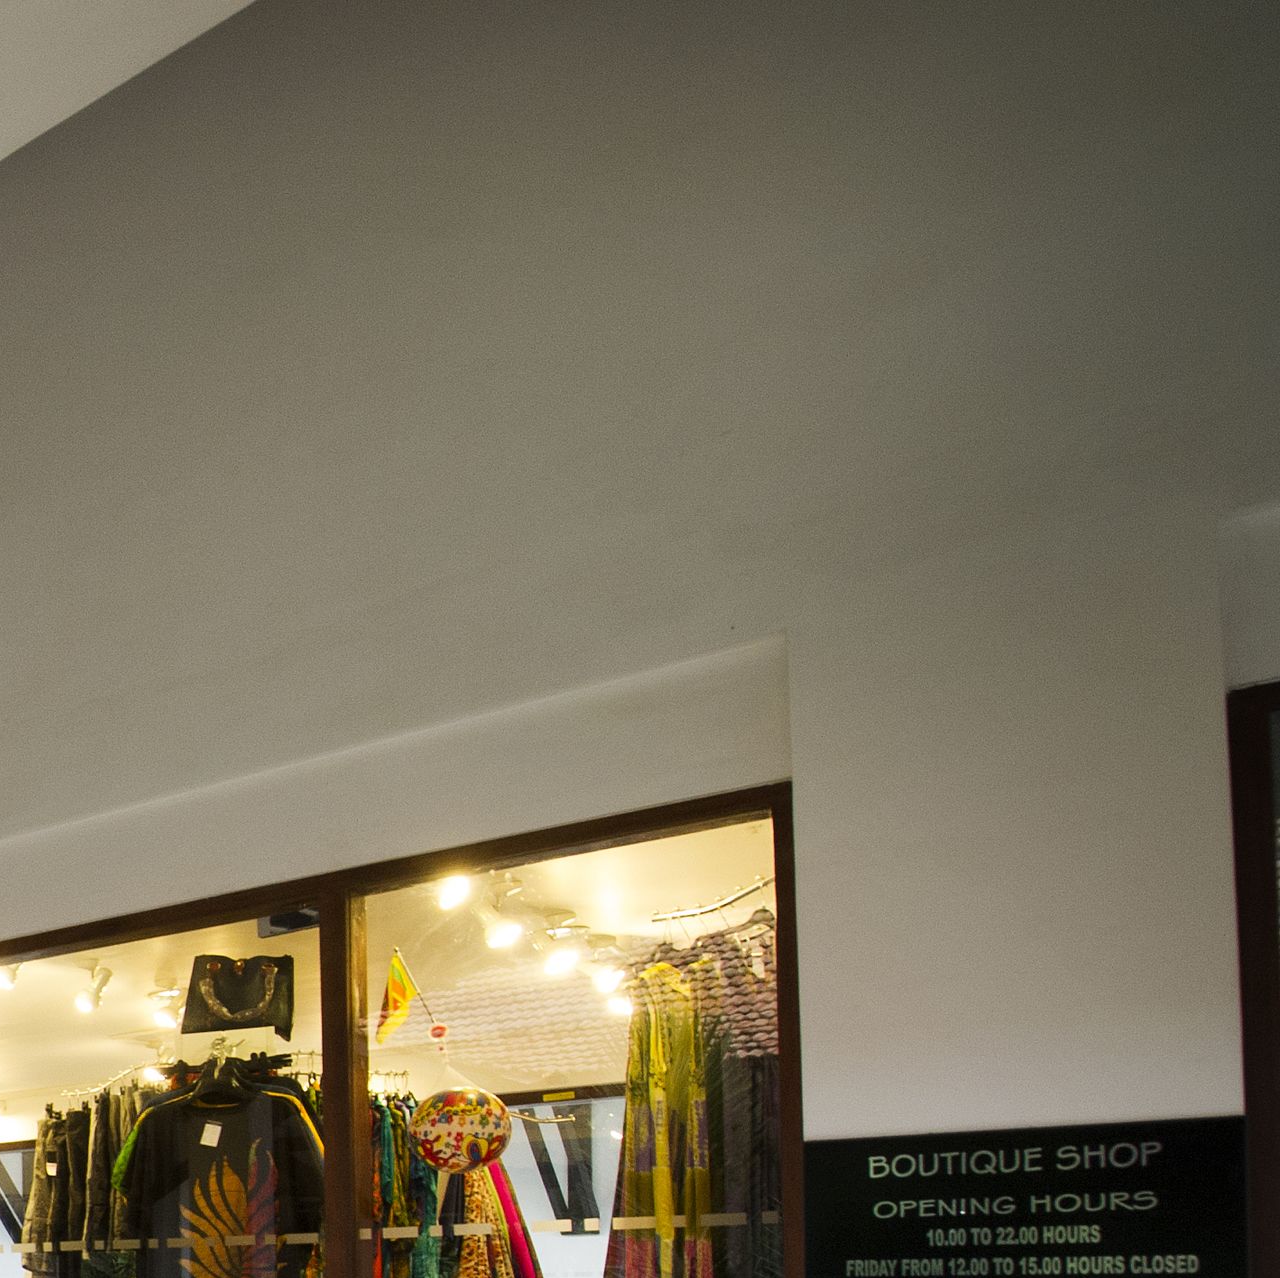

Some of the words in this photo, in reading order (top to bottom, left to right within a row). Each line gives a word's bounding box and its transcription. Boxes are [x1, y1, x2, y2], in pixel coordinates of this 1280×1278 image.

[868, 1147, 1042, 1179] BOUTIQUE
[1056, 1141, 1163, 1171] SHOP
[873, 1195, 1017, 1219] OPENING
[1030, 1190, 1158, 1214] HOURS
[926, 1228, 967, 1247] 10.00
[970, 1227, 991, 1246] TO
[996, 1226, 1038, 1246] 22.00
[1043, 1224, 1102, 1244] HOURS
[846, 1259, 897, 1277] FRIDAY
[901, 1258, 944, 1277] FROM
[948, 1257, 989, 1276] 12.00
[992, 1257, 1014, 1276] TO
[1019, 1256, 1062, 1275] 15.00
[1066, 1255, 1126, 1275] HOURS
[1130, 1254, 1200, 1274] CLOSED
